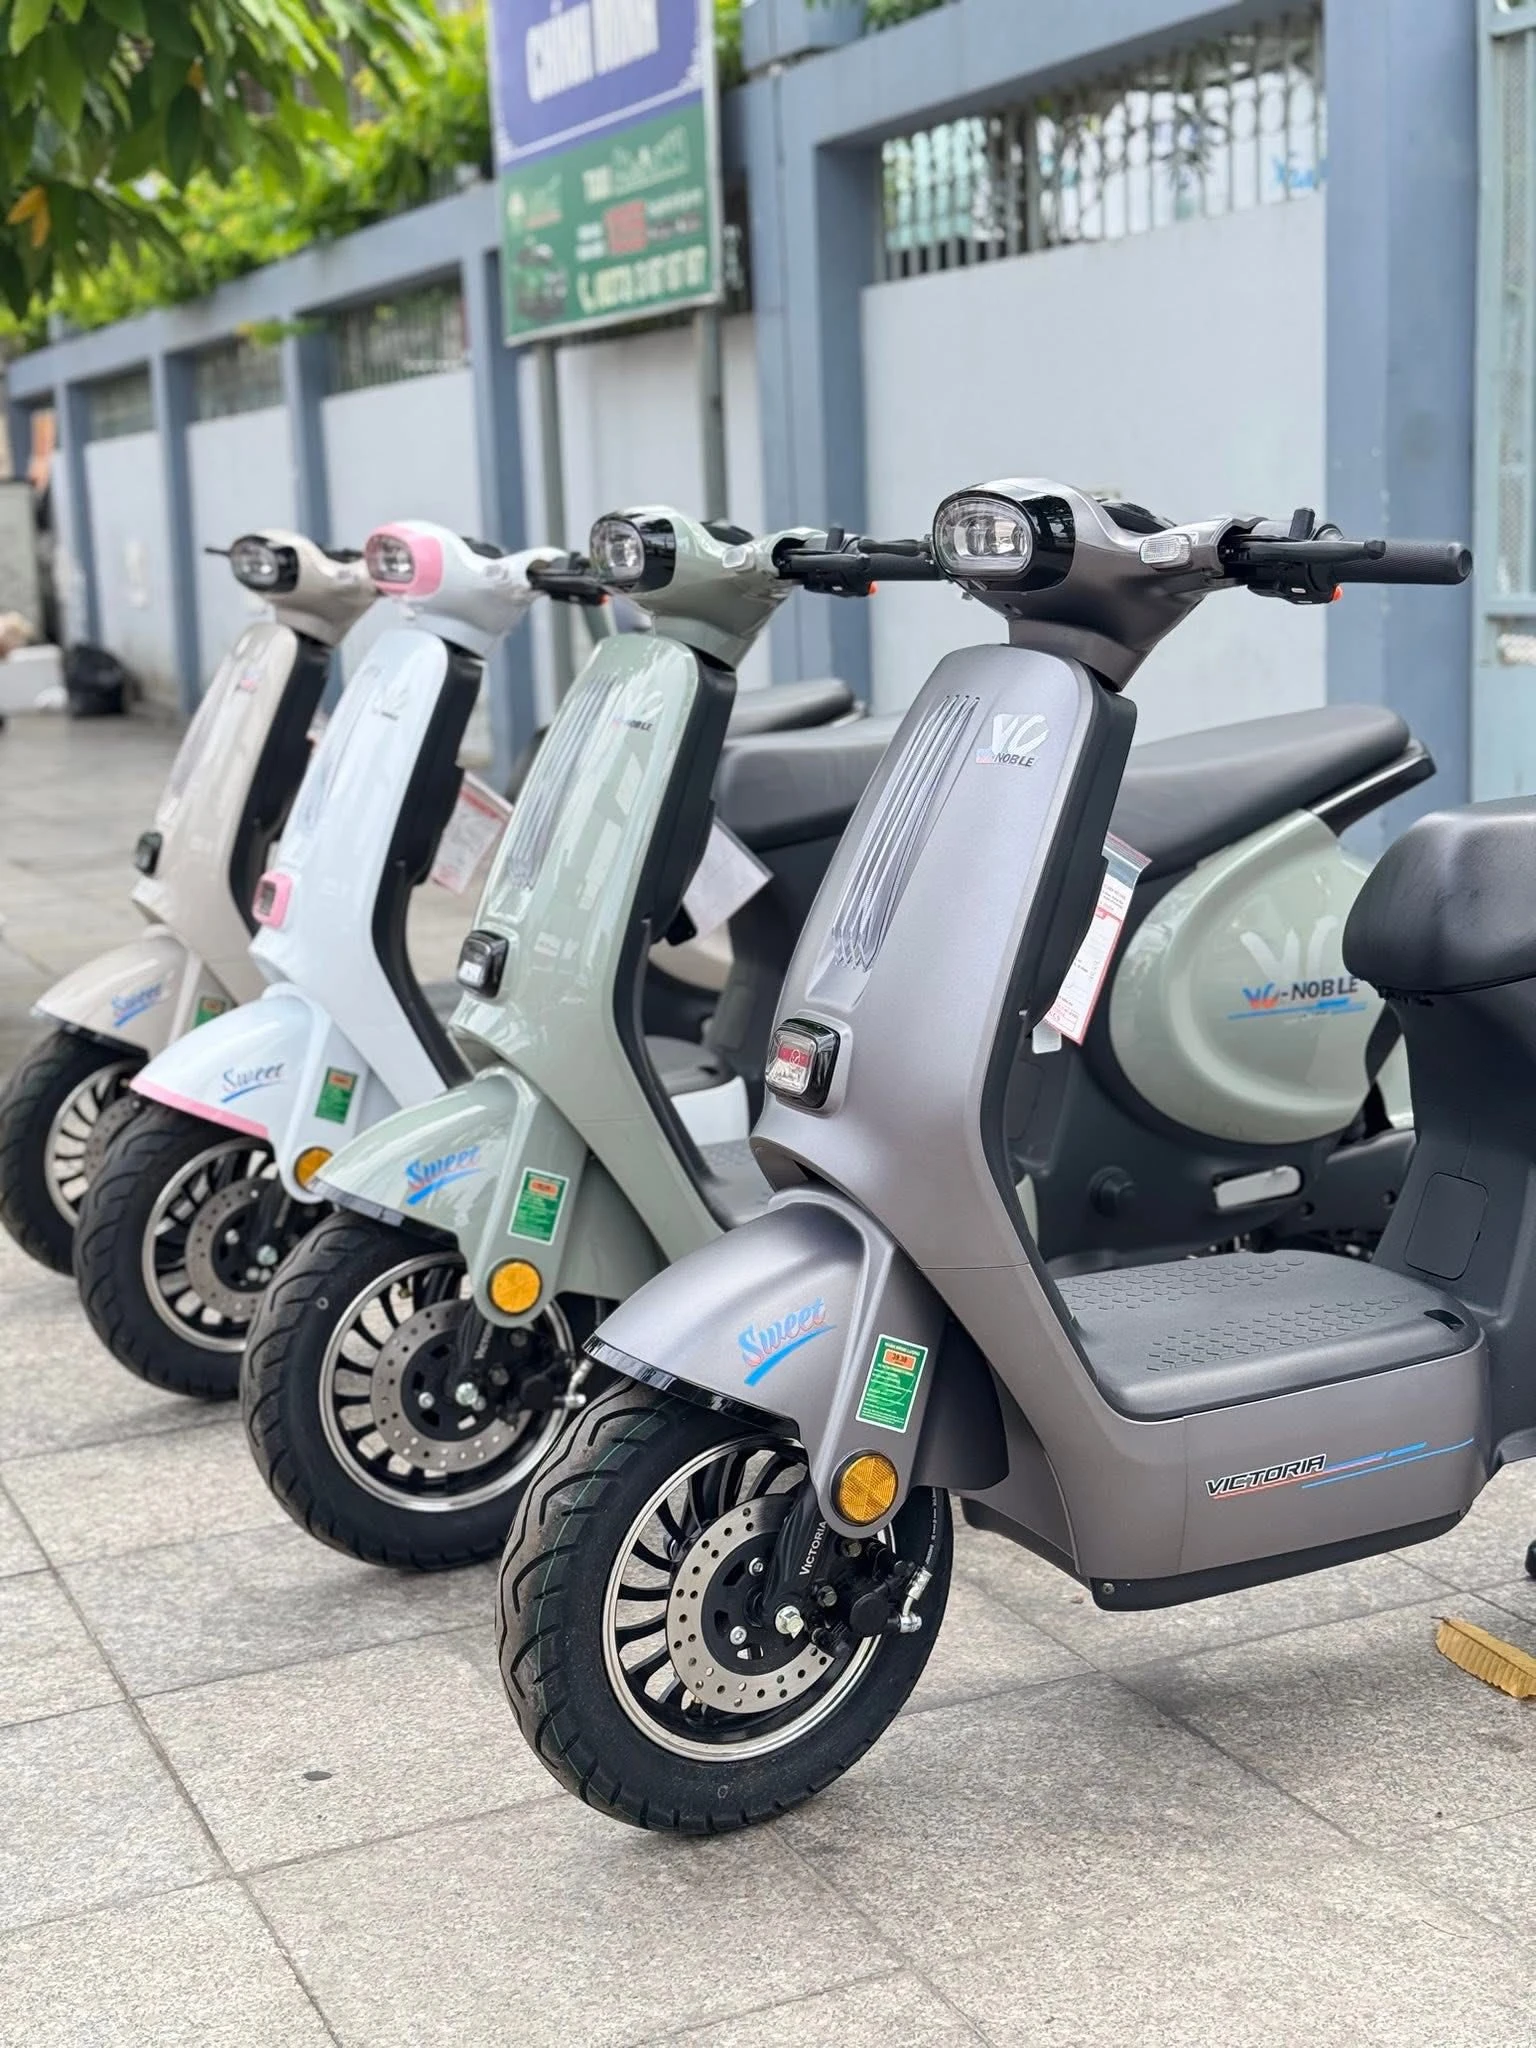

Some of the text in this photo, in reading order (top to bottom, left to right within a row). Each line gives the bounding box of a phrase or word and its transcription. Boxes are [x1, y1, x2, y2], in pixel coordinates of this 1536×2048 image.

[993, 752, 1035, 767] NOBLE
[222, 1062, 285, 1092] Sweet
[405, 1145, 480, 1191] Sweet
[738, 1296, 827, 1367] Sweet
[1205, 1453, 1326, 1496] VICTORIA
[799, 1520, 827, 1576] VICTORIA
